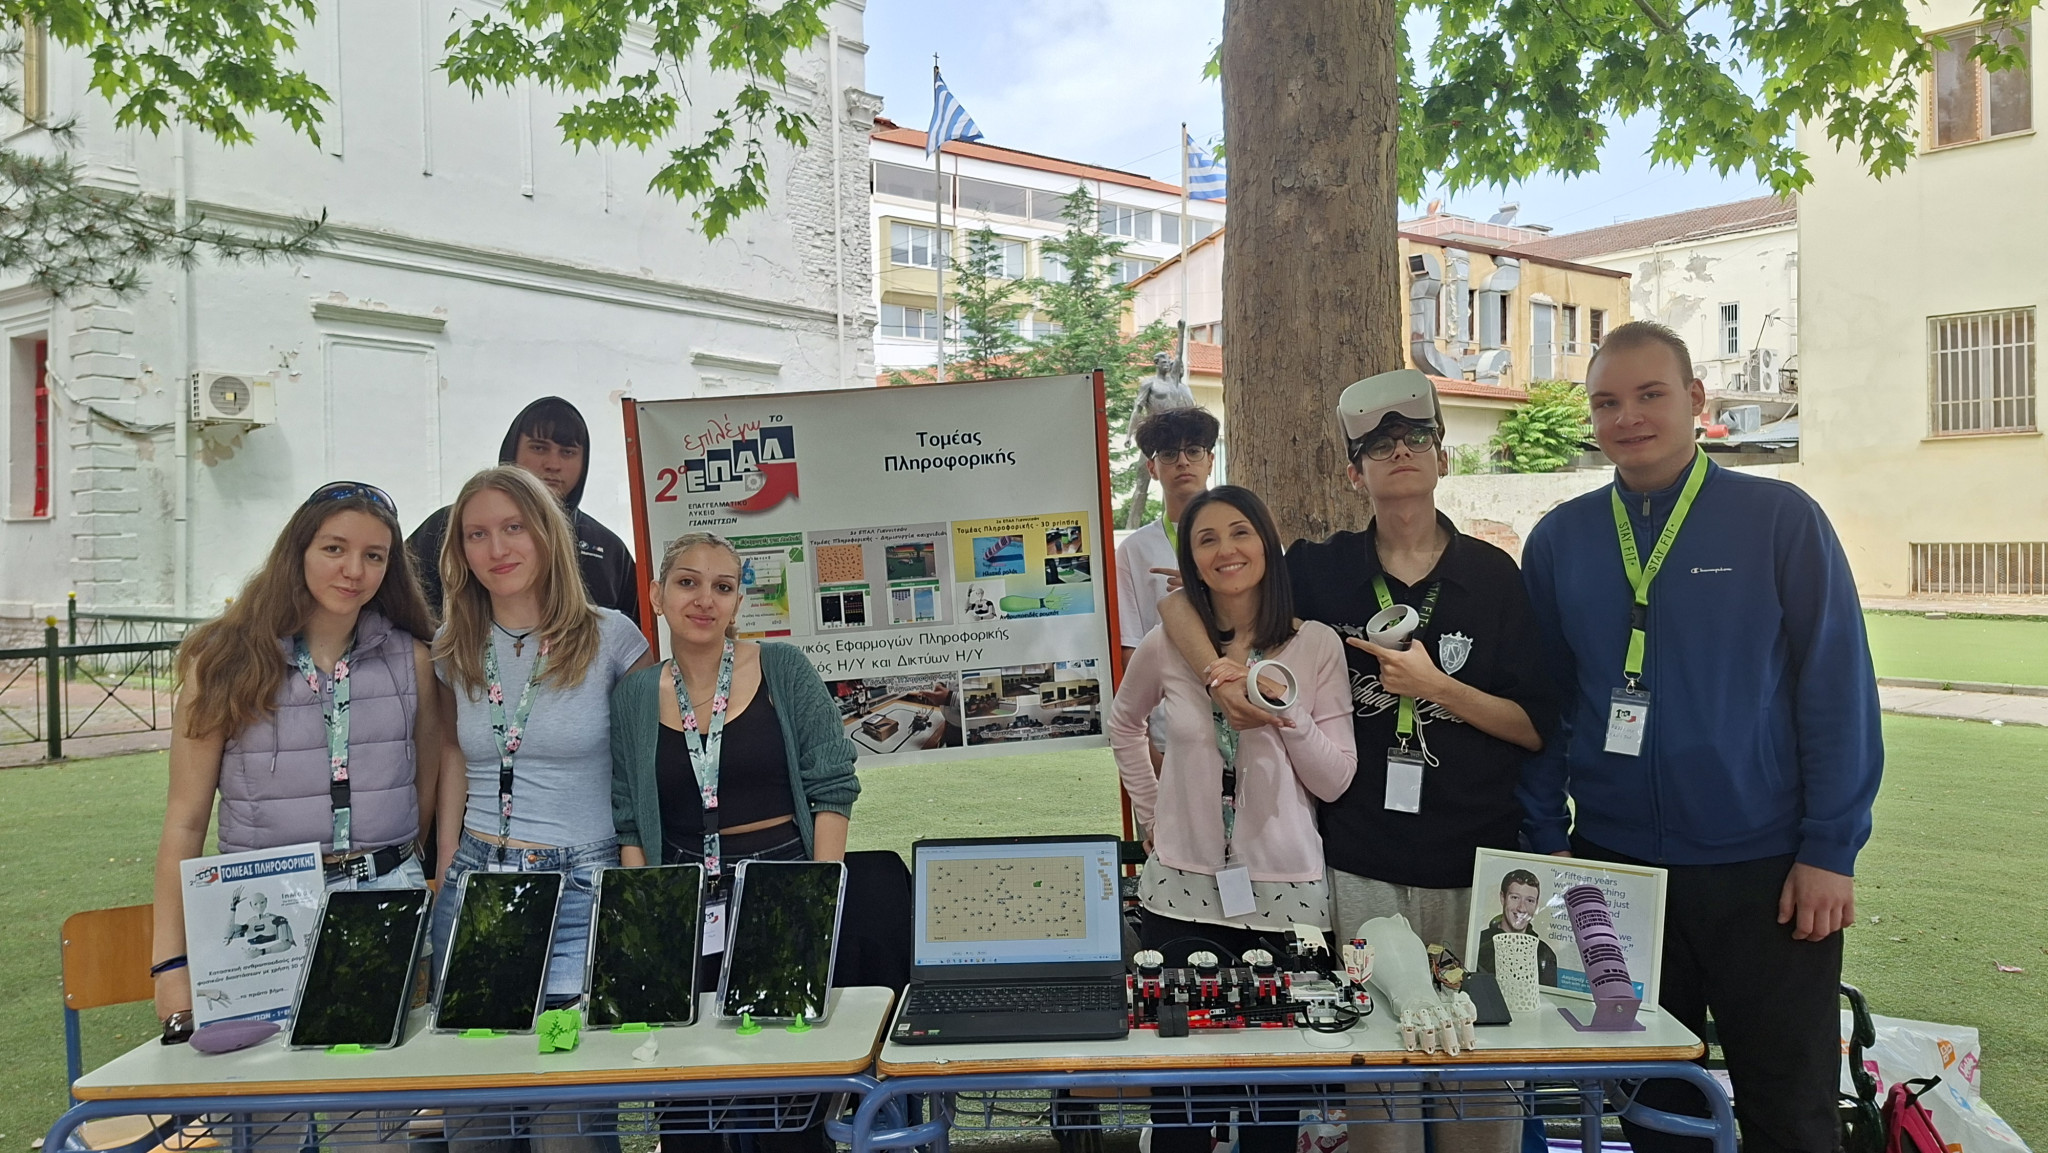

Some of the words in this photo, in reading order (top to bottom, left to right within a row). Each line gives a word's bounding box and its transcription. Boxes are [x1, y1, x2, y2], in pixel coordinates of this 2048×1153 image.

[915, 429, 982, 450] Τομέας
[686, 437, 784, 492] ΕΠΑΛ
[884, 448, 1016, 473] Πληροφορικής
[688, 500, 748, 510] ΕΠΑΓΓΕΛΜΑΤΙΚΟ
[688, 518, 738, 527] ΓΙΑΝΝΙΤΣΩΝ
[984, 523, 1034, 532] Πληροφορικής
[1619, 521, 1632, 542] STAY
[1648, 548, 1664, 572] STAY
[836, 636, 914, 653] Εφαρμογών
[919, 628, 1010, 648] Πληροφορικής
[837, 658, 866, 672] Η/Υ
[872, 659, 891, 668] και
[897, 652, 950, 666] Δικτύων
[956, 648, 984, 662] Η/Υ
[221, 864, 253, 879] ΤΟΜΕΑΣ
[254, 856, 314, 874] ΠΛΗΡΟΦΟΡΙΚΗΣ
[1565, 872, 1592, 882] fifteen
[1594, 876, 1618, 886] years
[1602, 888, 1626, 898] ching
[1613, 900, 1630, 910] just
